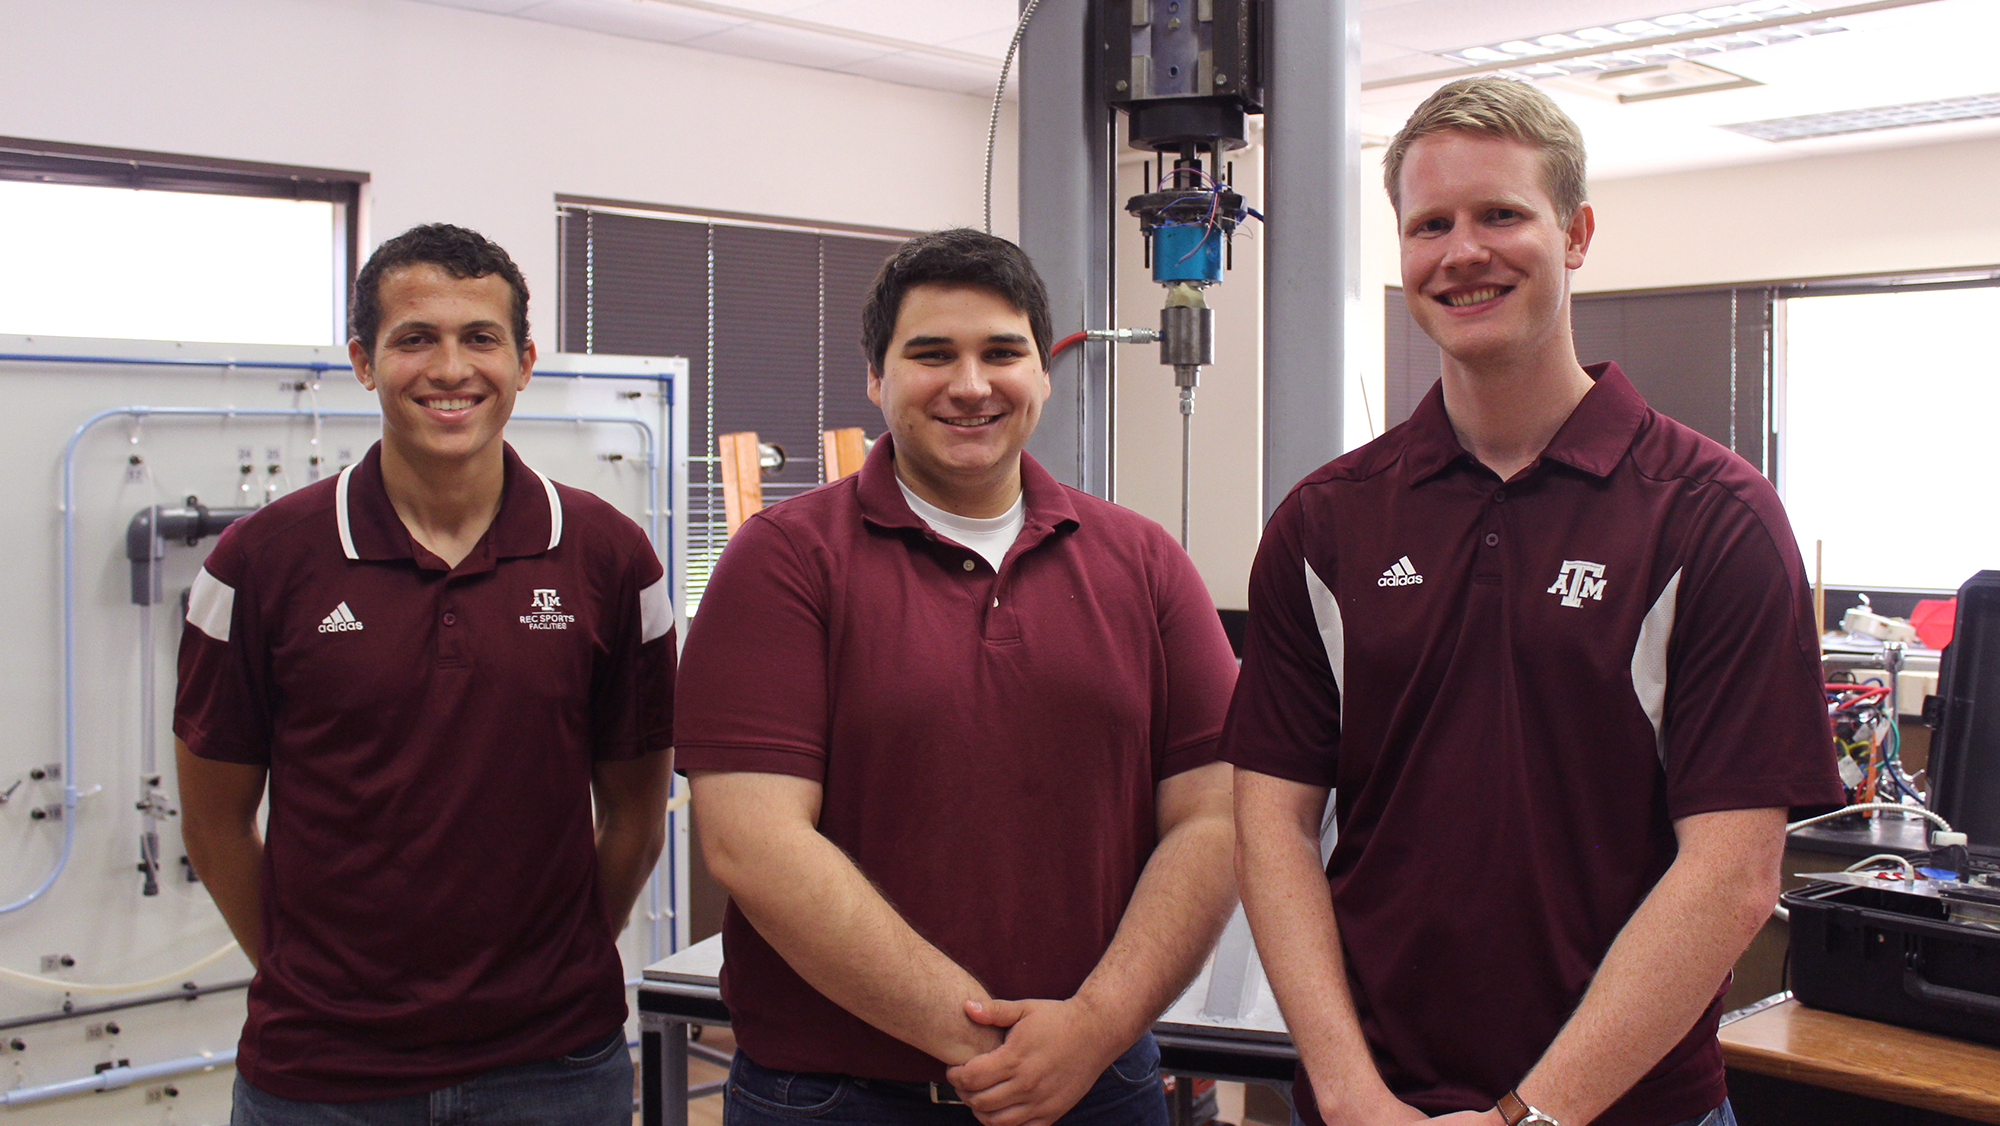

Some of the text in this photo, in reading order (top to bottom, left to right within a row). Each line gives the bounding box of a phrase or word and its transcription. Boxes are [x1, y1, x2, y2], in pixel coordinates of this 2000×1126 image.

[1377, 574, 1424, 587] adidas
[519, 614, 575, 624] REC SPORTS
[317, 621, 364, 633] adidas
[528, 622, 567, 630] FACILITIES
